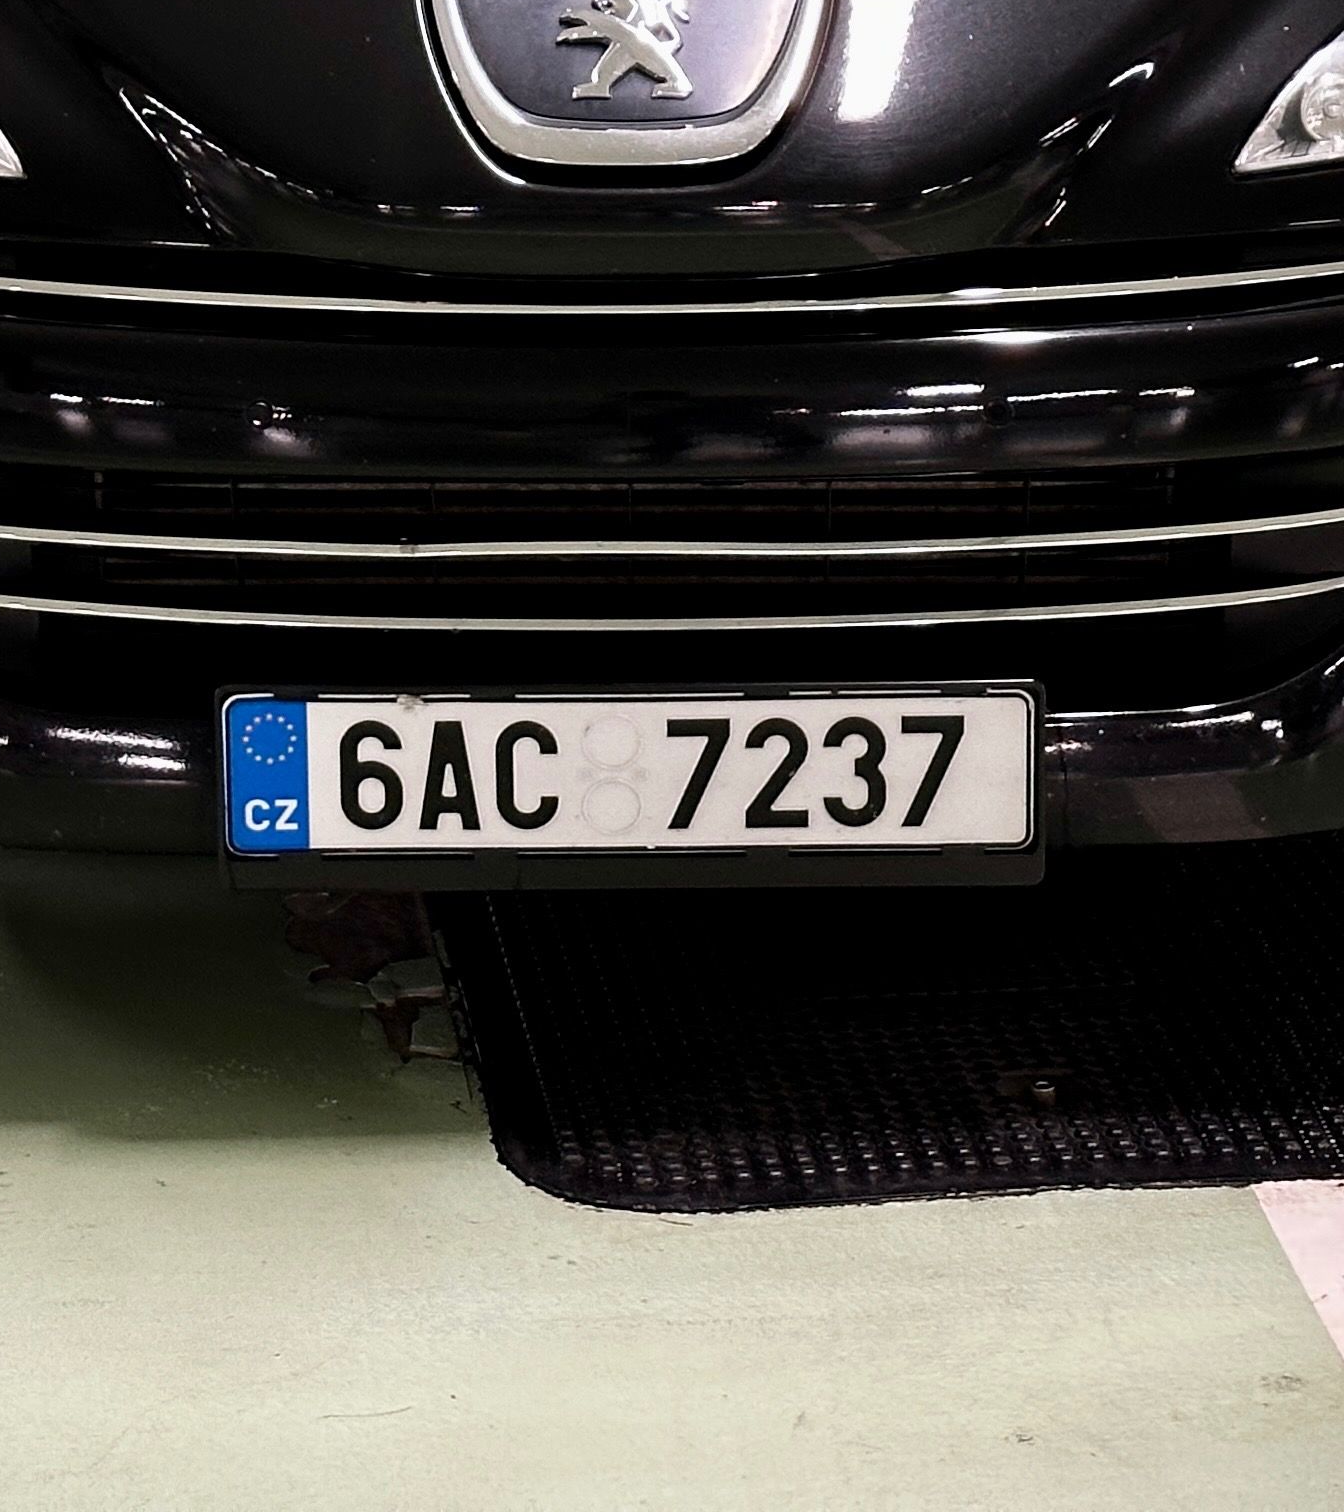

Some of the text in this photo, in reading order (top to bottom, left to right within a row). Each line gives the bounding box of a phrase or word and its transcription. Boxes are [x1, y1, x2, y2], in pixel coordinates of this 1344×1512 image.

[339, 714, 965, 831] 6AC 7237
[243, 798, 299, 832] CZ
